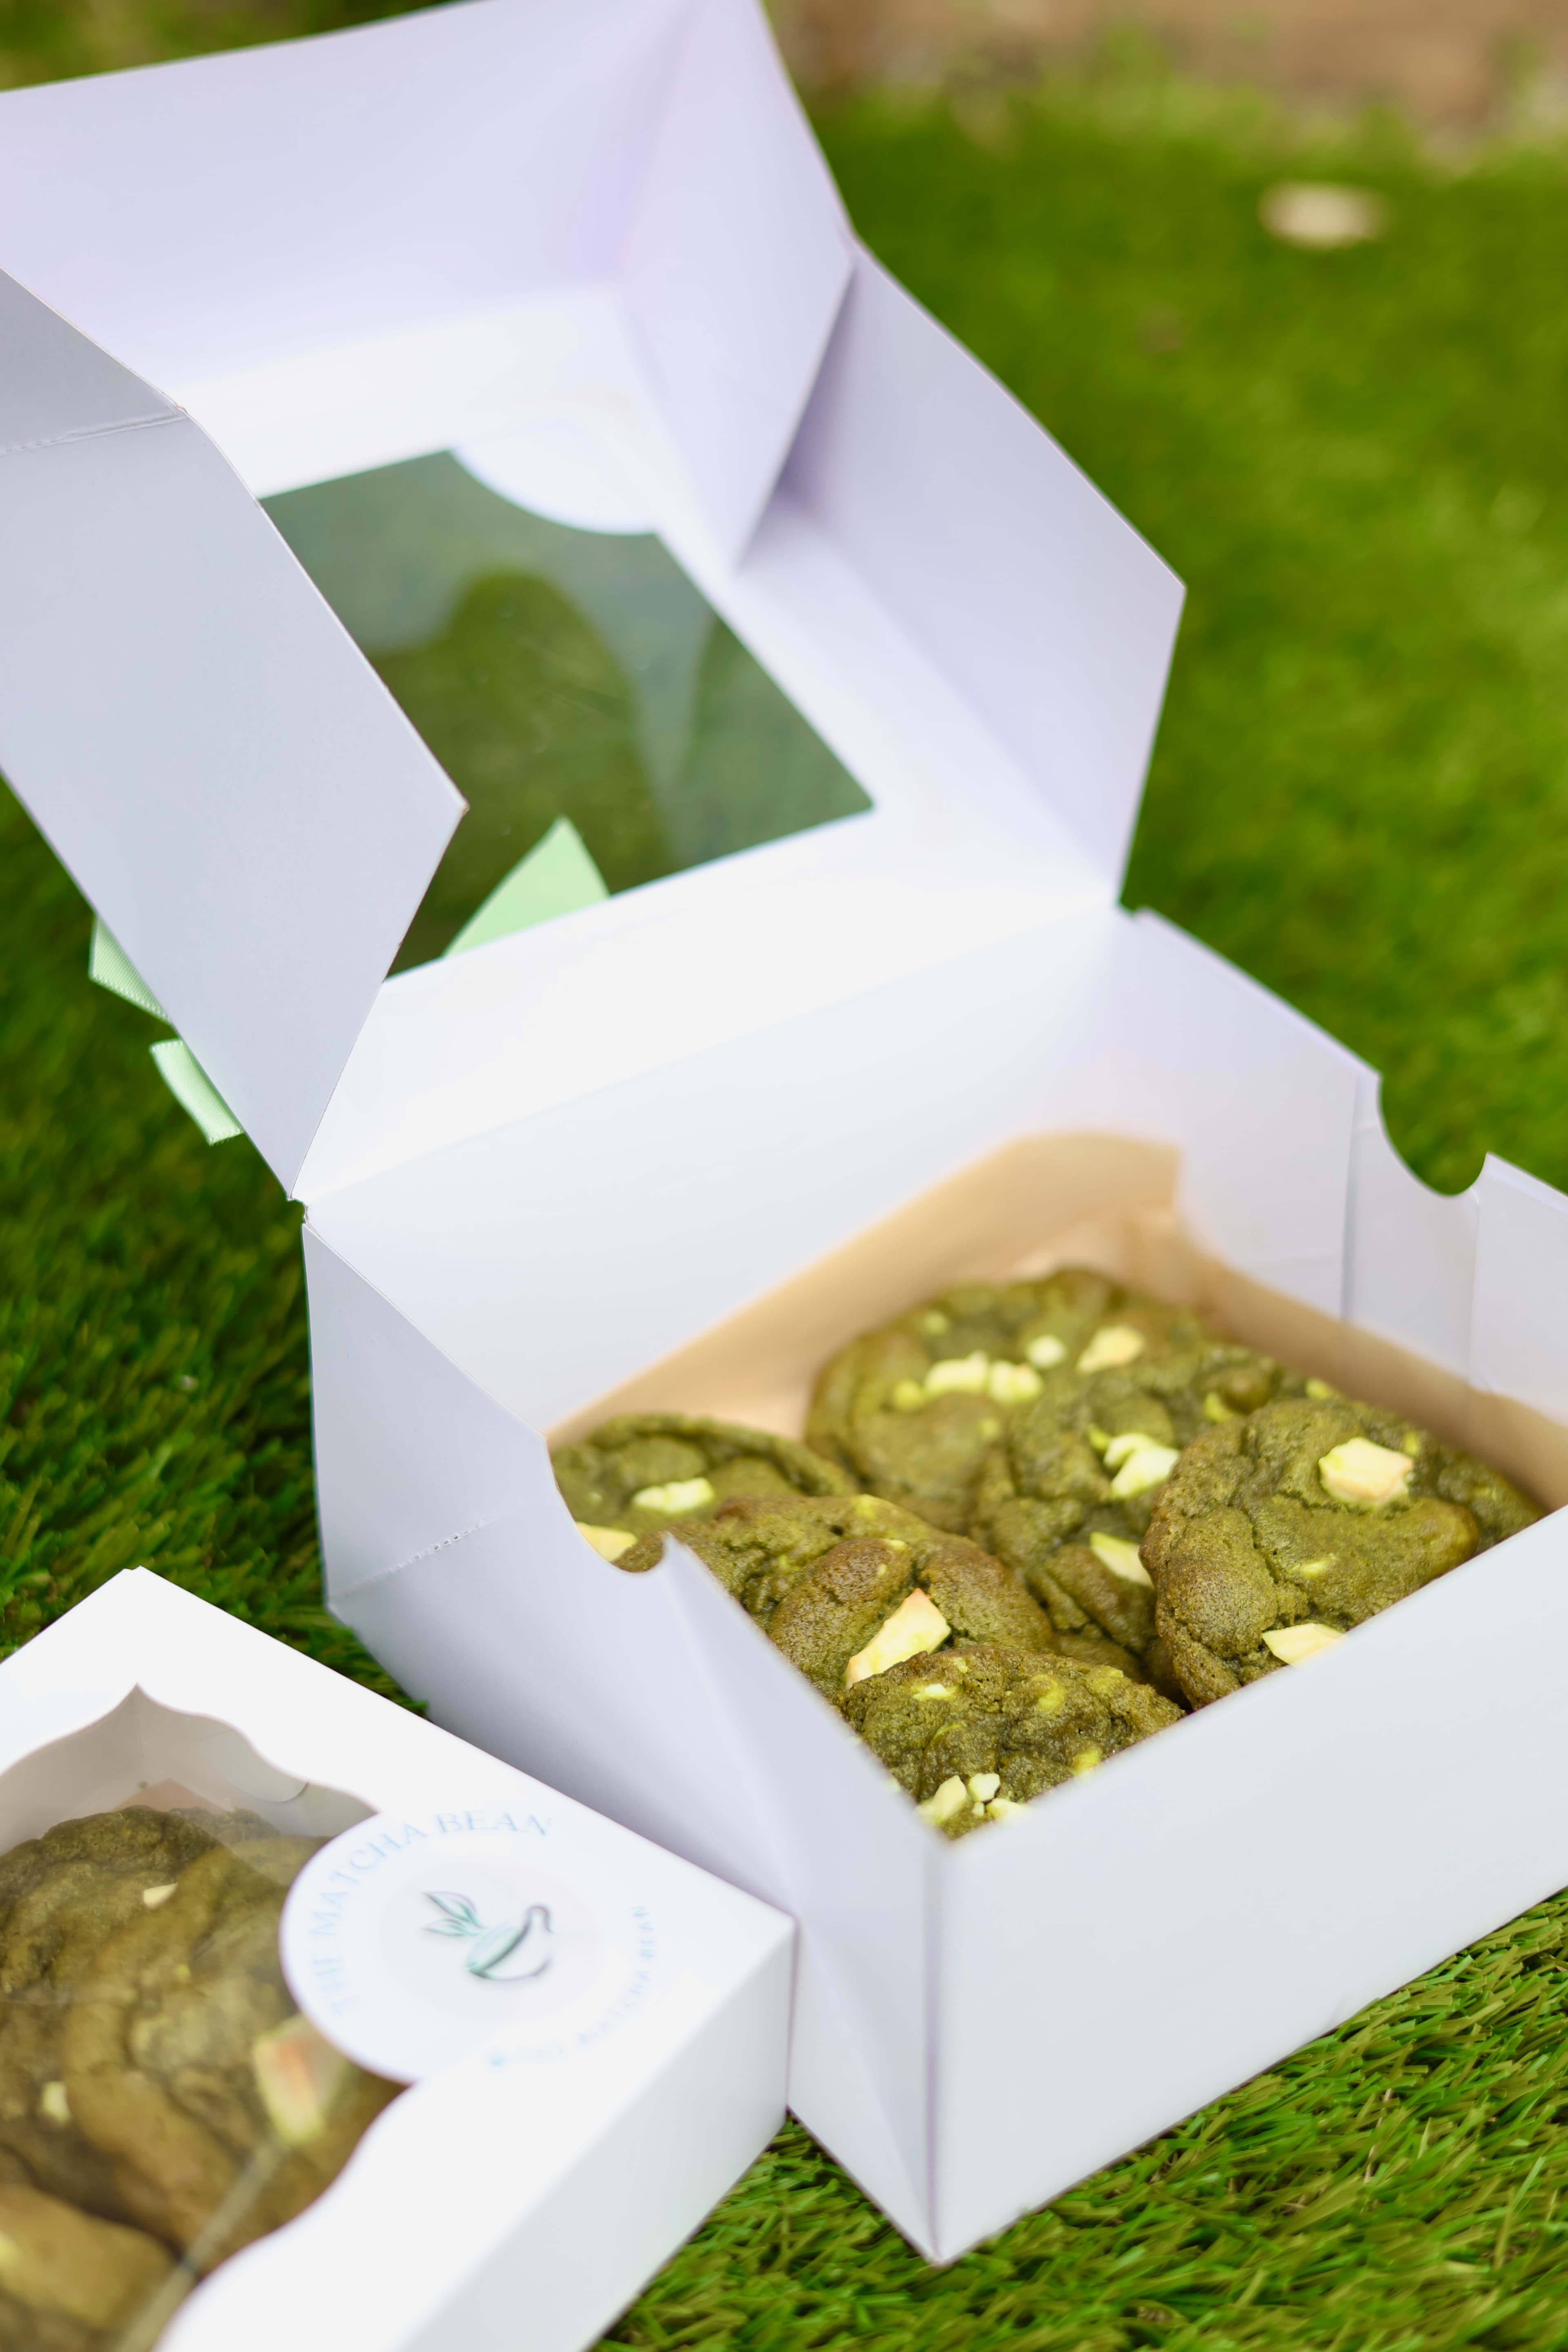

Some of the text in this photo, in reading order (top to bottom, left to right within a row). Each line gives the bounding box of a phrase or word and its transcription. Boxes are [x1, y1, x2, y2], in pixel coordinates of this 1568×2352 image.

[309, 1810, 553, 2016] THE MATCHA BEAN
